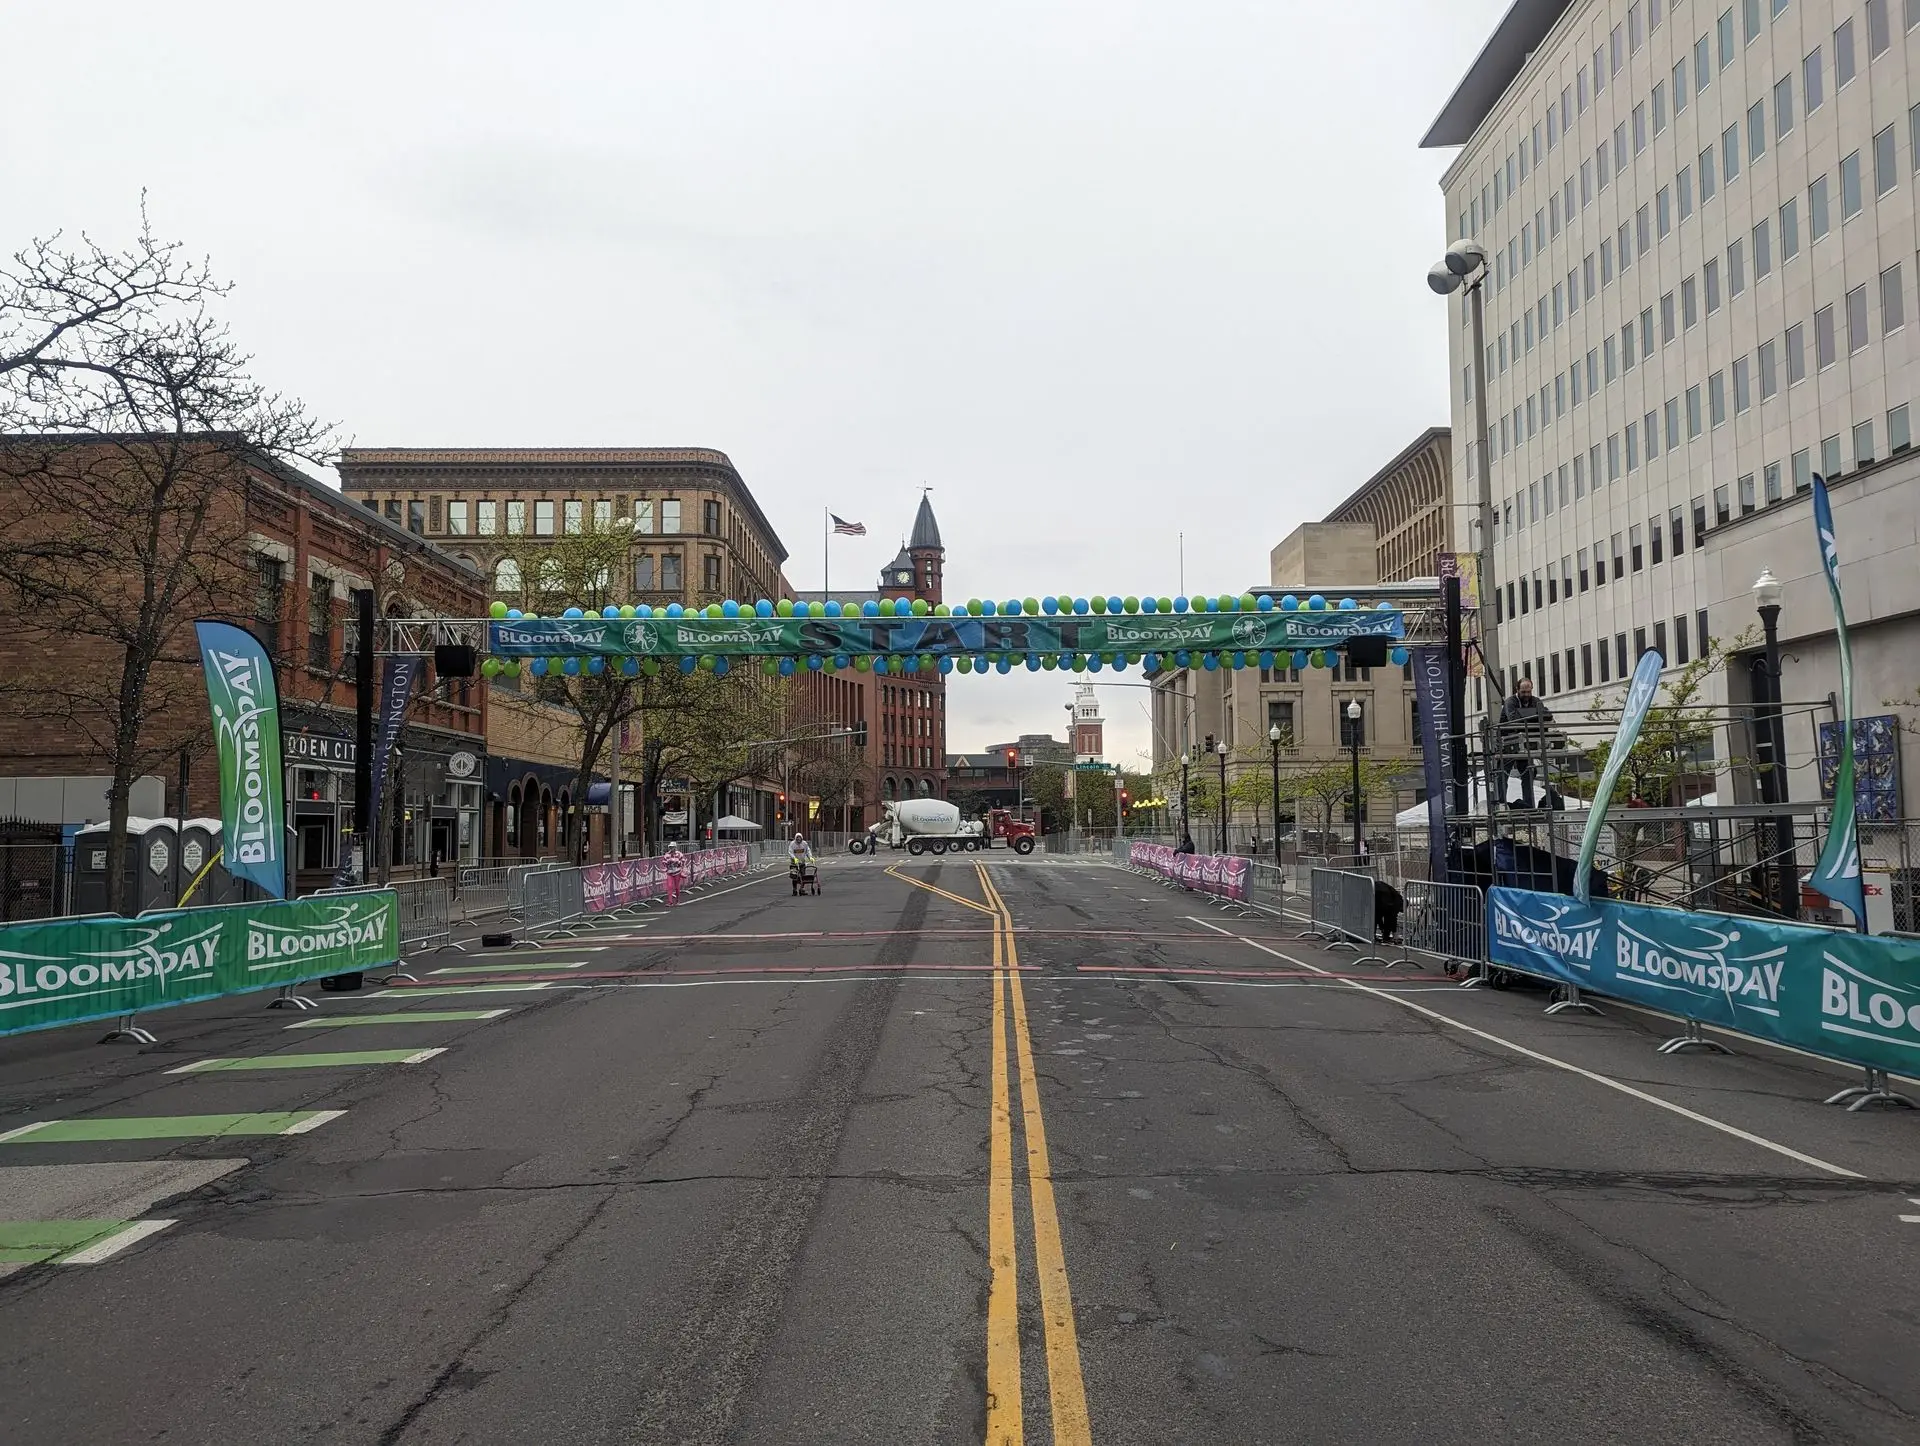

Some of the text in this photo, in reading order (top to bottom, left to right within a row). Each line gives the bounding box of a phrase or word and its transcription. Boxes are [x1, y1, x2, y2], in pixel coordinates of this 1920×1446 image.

[499, 629, 605, 644] BLOOMSDAY
[677, 628, 783, 643] BLOOMSDAY
[798, 620, 1096, 650] START
[1106, 623, 1213, 640] BLOOMSDAY
[1286, 622, 1394, 637] BLOOMSDAY
[219, 652, 266, 864] BLOOMSDAY
[288, 736, 356, 760] ODEN CIT
[247, 912, 388, 961] BLOOMSDAY
[1494, 906, 1601, 960] BLOOMSDAY
[0, 934, 221, 997] BLOOMSDAY
[1616, 931, 1785, 1002] BLOOMSDAY
